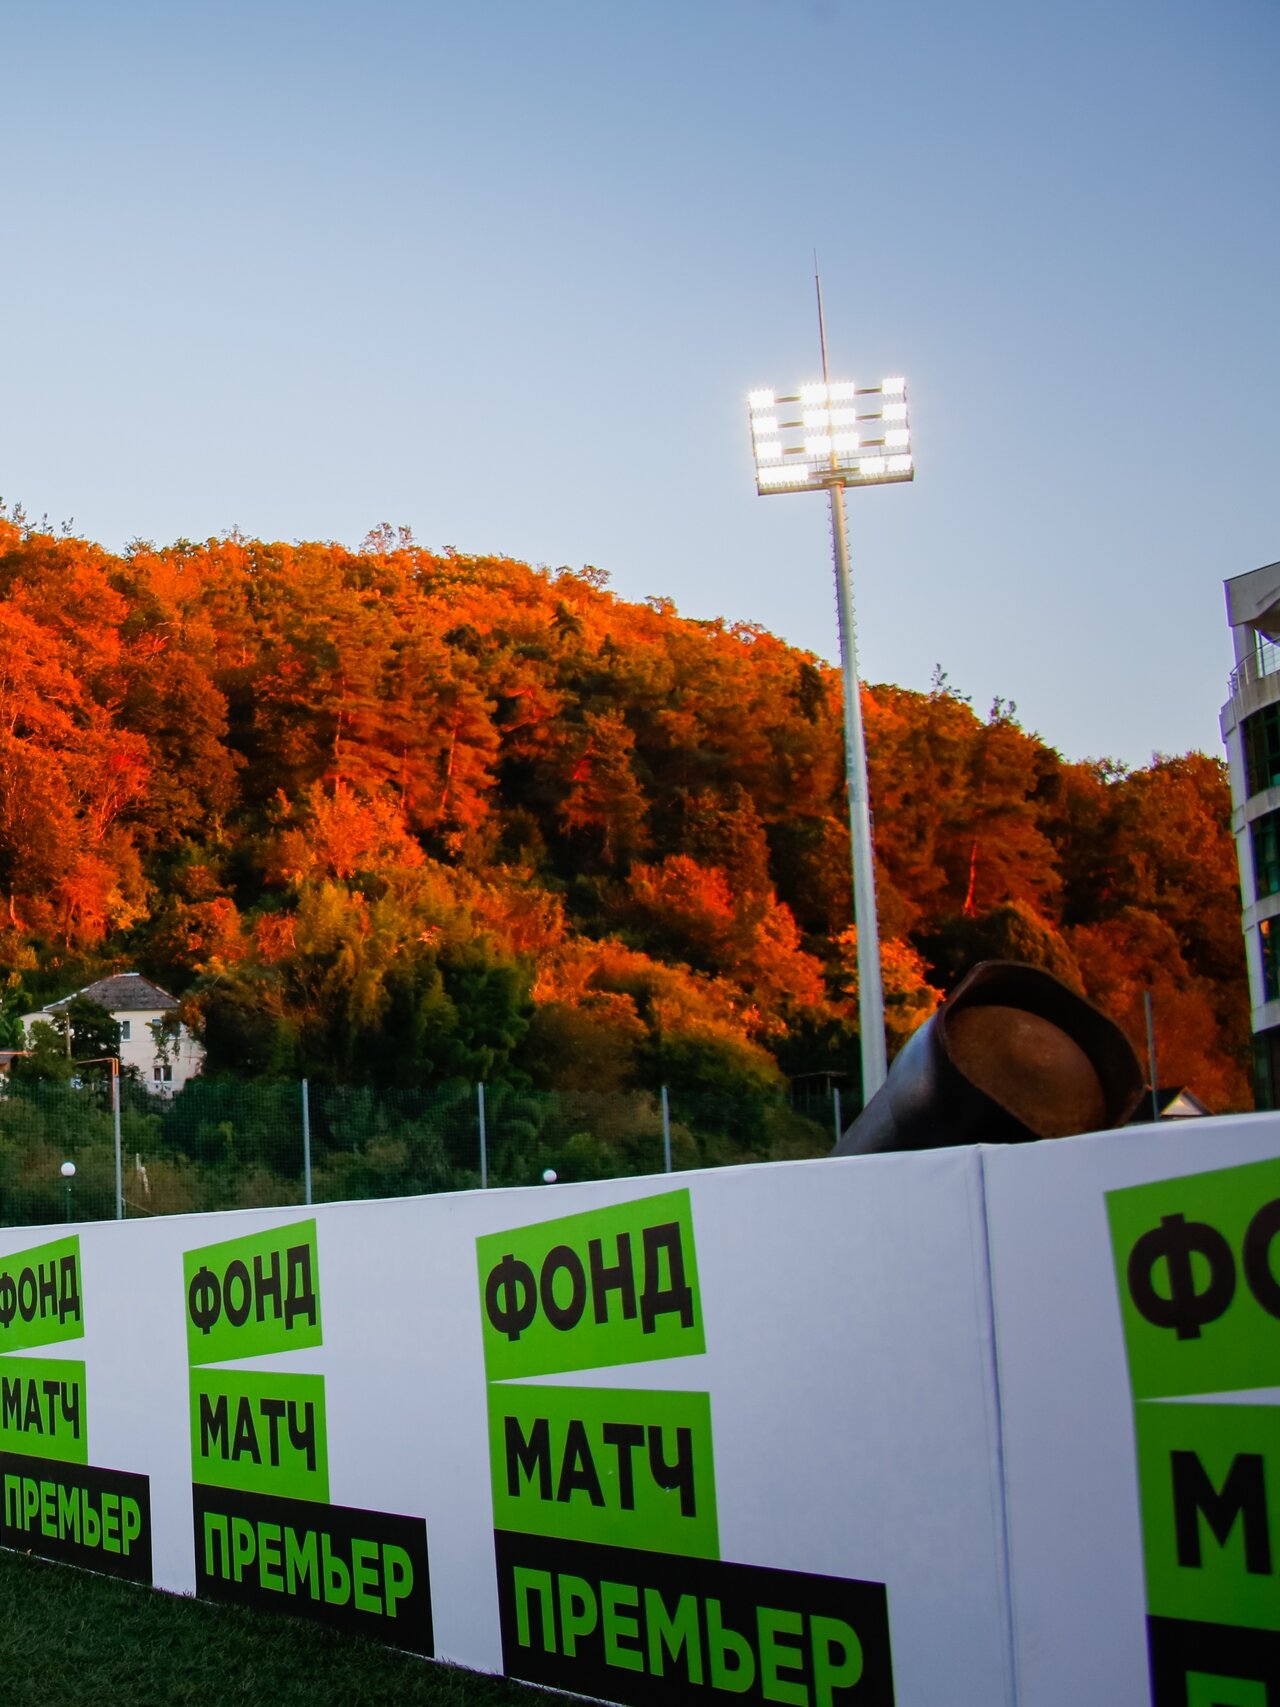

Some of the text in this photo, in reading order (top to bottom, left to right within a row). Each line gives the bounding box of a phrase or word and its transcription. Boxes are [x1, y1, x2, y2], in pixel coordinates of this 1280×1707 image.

[188, 1243, 316, 1335] ФОНД
[484, 1221, 694, 1341] ФОНД
[2, 1377, 80, 1439] МАТЧ
[199, 1393, 317, 1472] МАТЧ
[4, 1474, 141, 1556] ПРЕМЬЕР
[504, 1415, 696, 1518] МАТЧ
[203, 1511, 414, 1618] ПРЕМЬЕР
[513, 1566, 864, 1707] ПРЕМЬЕР
